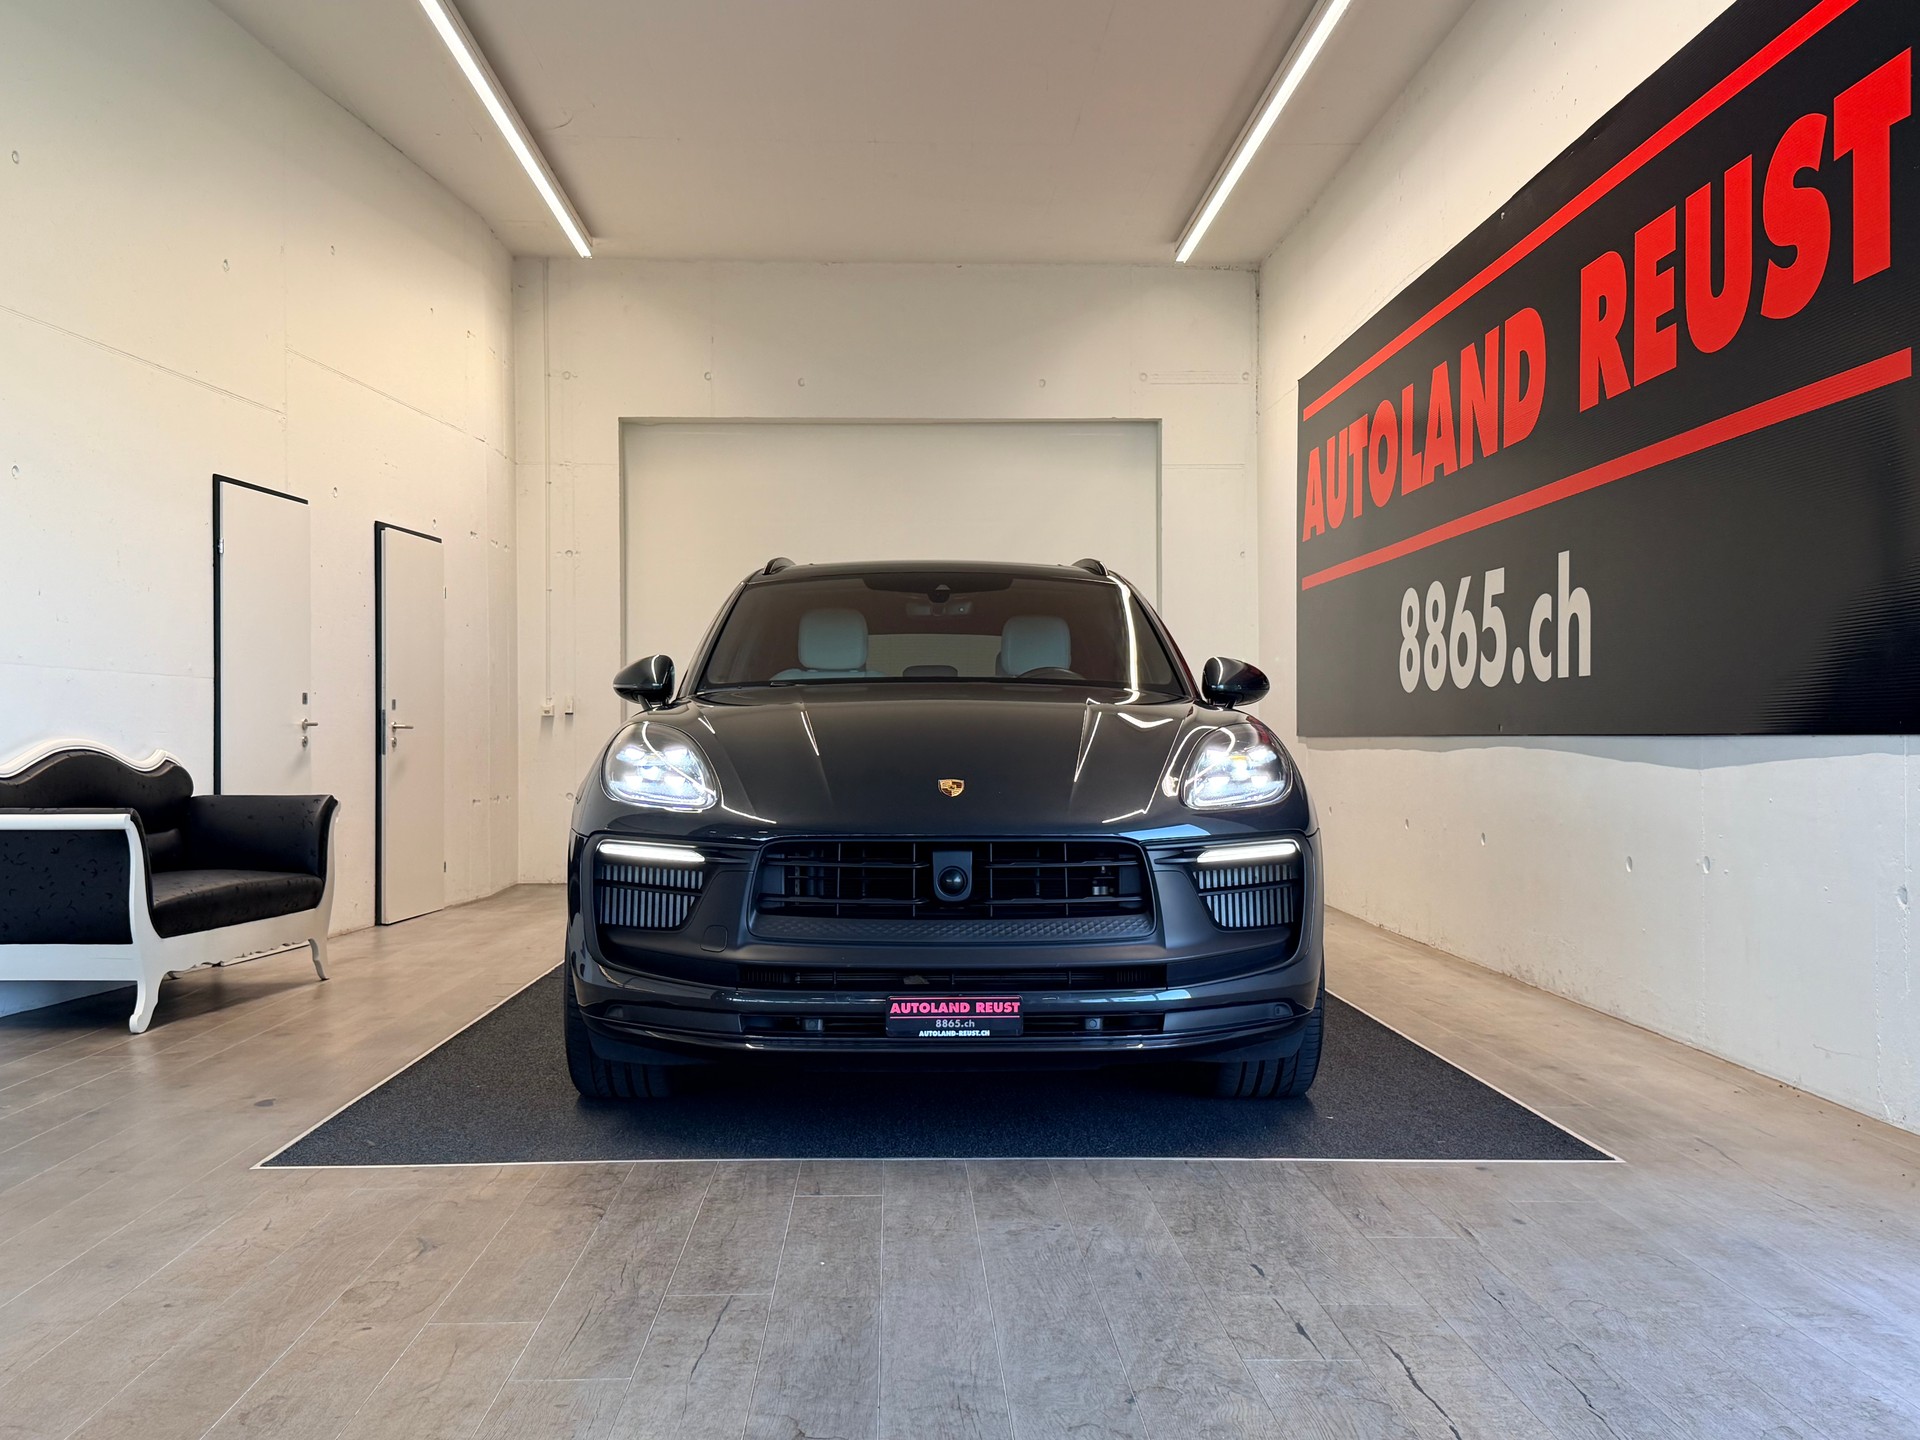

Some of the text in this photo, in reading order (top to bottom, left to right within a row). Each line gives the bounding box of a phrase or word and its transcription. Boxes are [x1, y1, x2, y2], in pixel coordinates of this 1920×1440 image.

[1302, 47, 1911, 542] AUTOLAND REUST
[1399, 550, 1592, 693] 8865.ch
[889, 1002, 1020, 1013] AUTOLAND REUST
[935, 1019, 975, 1028] 8865.ch
[919, 1029, 990, 1037] AUTOLAND-REUST.CH
